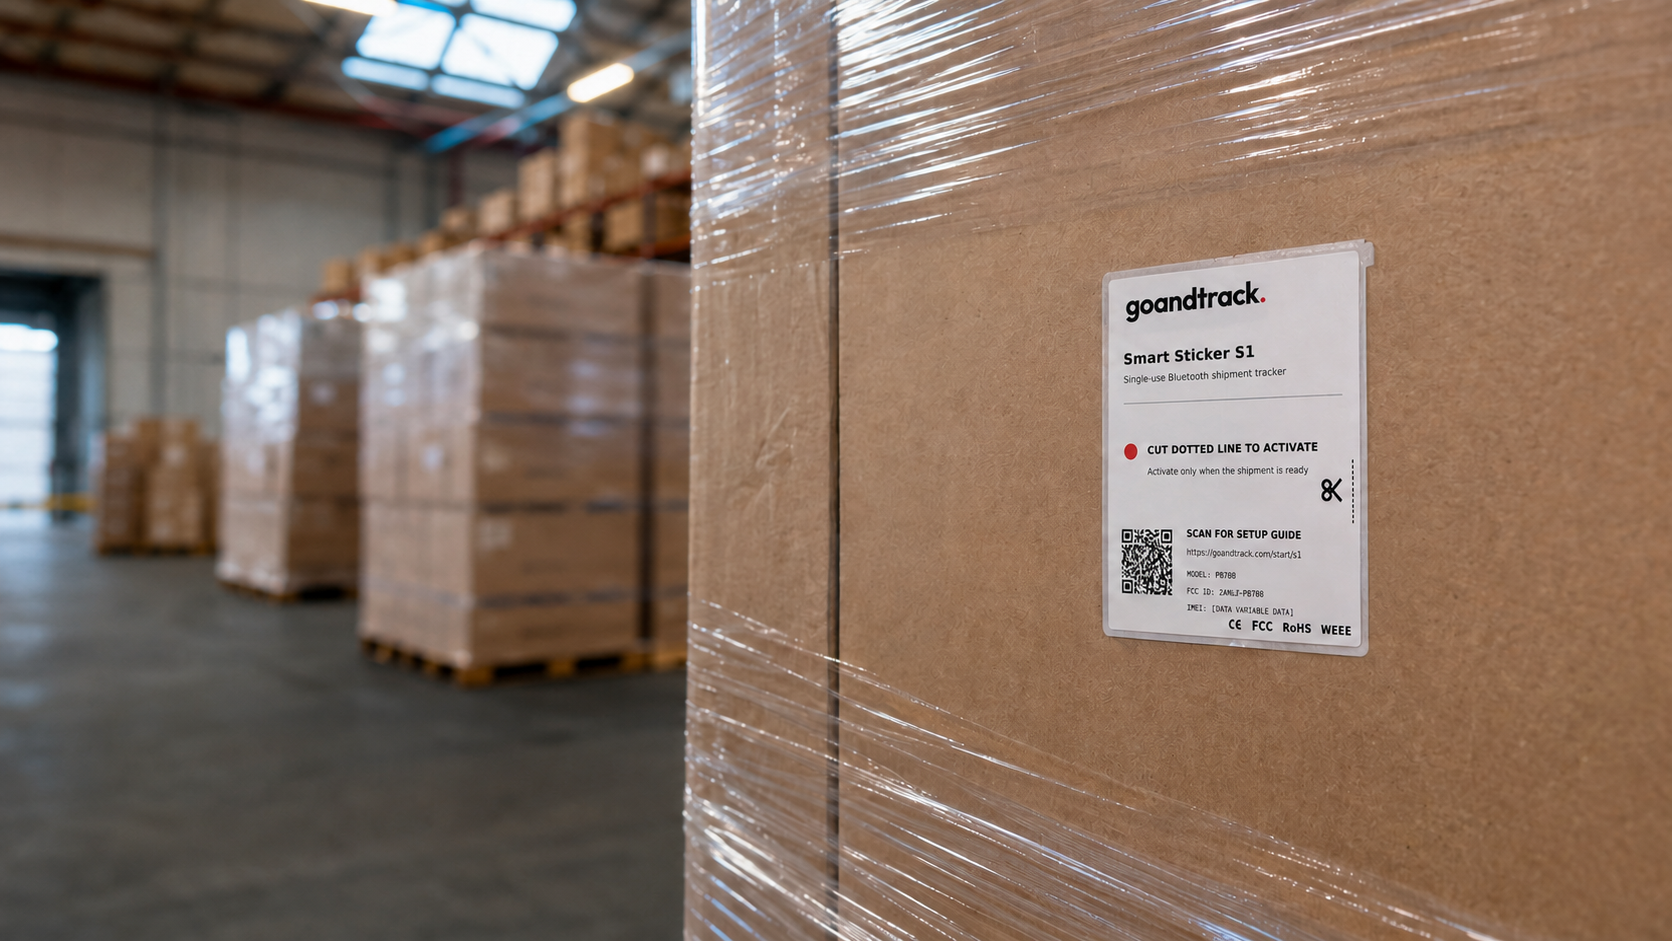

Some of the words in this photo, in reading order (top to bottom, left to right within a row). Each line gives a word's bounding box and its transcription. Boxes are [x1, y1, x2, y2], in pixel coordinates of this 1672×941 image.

[1126, 281, 1266, 323] goandtrack.
[1124, 351, 1170, 365] Smart
[1175, 348, 1230, 362] Sticker
[1236, 345, 1254, 358] S1
[1124, 375, 1165, 385] Single-use
[1168, 372, 1208, 381] Bluetooth
[1212, 370, 1252, 380] shipment
[1255, 368, 1286, 376] tracker
[1148, 445, 1168, 454] CUT
[1172, 444, 1214, 454] DOTTED
[1218, 444, 1241, 453] LINE
[1245, 443, 1260, 453] TO
[1263, 442, 1318, 452] ACTIVATE
[1181, 468, 1197, 476] only
[1199, 467, 1220, 475] when
[1222, 467, 1235, 475] the
[1237, 466, 1274, 476] shipment
[1277, 466, 1283, 474] is
[1286, 466, 1308, 475] ready
[1187, 529, 1211, 538] SCAN
[1215, 529, 1234, 538] FOR
[1237, 530, 1268, 539] SETUP
[1271, 530, 1301, 539] GUIDE
[1187, 548, 1301, 559] https://goandtrack.com/start/s1
[1212, 605, 1232, 613] [DATA
[1236, 607, 1268, 615] VARIABLE
[1273, 608, 1293, 617] DATA]
[1252, 620, 1273, 631] FCC
[1283, 622, 1311, 633] RoHS
[1321, 625, 1351, 636] WEEE
